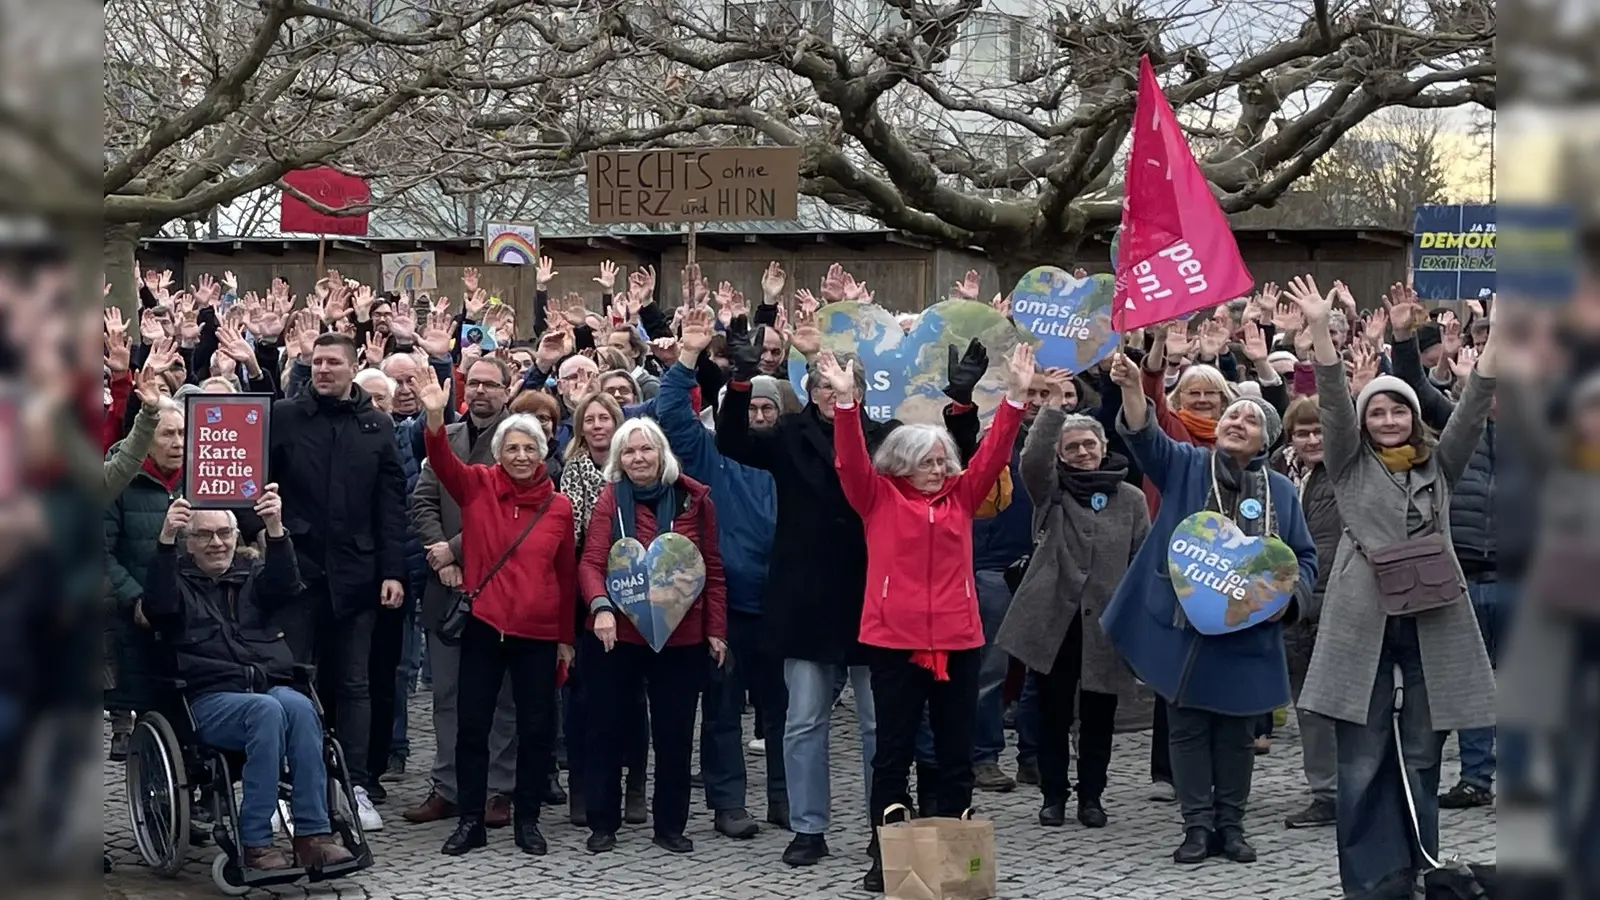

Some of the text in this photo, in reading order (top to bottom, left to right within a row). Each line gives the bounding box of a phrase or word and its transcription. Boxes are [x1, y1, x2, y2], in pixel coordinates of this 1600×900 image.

[596, 152, 769, 190] RECHTS ohne
[597, 188, 775, 218] HERZ und HIRN
[1470, 224, 1483, 232] JA
[1420, 232, 1496, 248] DEMOK
[1014, 297, 1090, 328] omas for
[1031, 318, 1091, 341] future
[199, 426, 238, 442] Rote
[198, 444, 247, 460] Karte
[198, 461, 253, 477] für die
[197, 479, 236, 495] AfD!
[1171, 539, 1249, 587] omas for
[611, 572, 645, 592] OMAS
[1183, 563, 1247, 601] future
